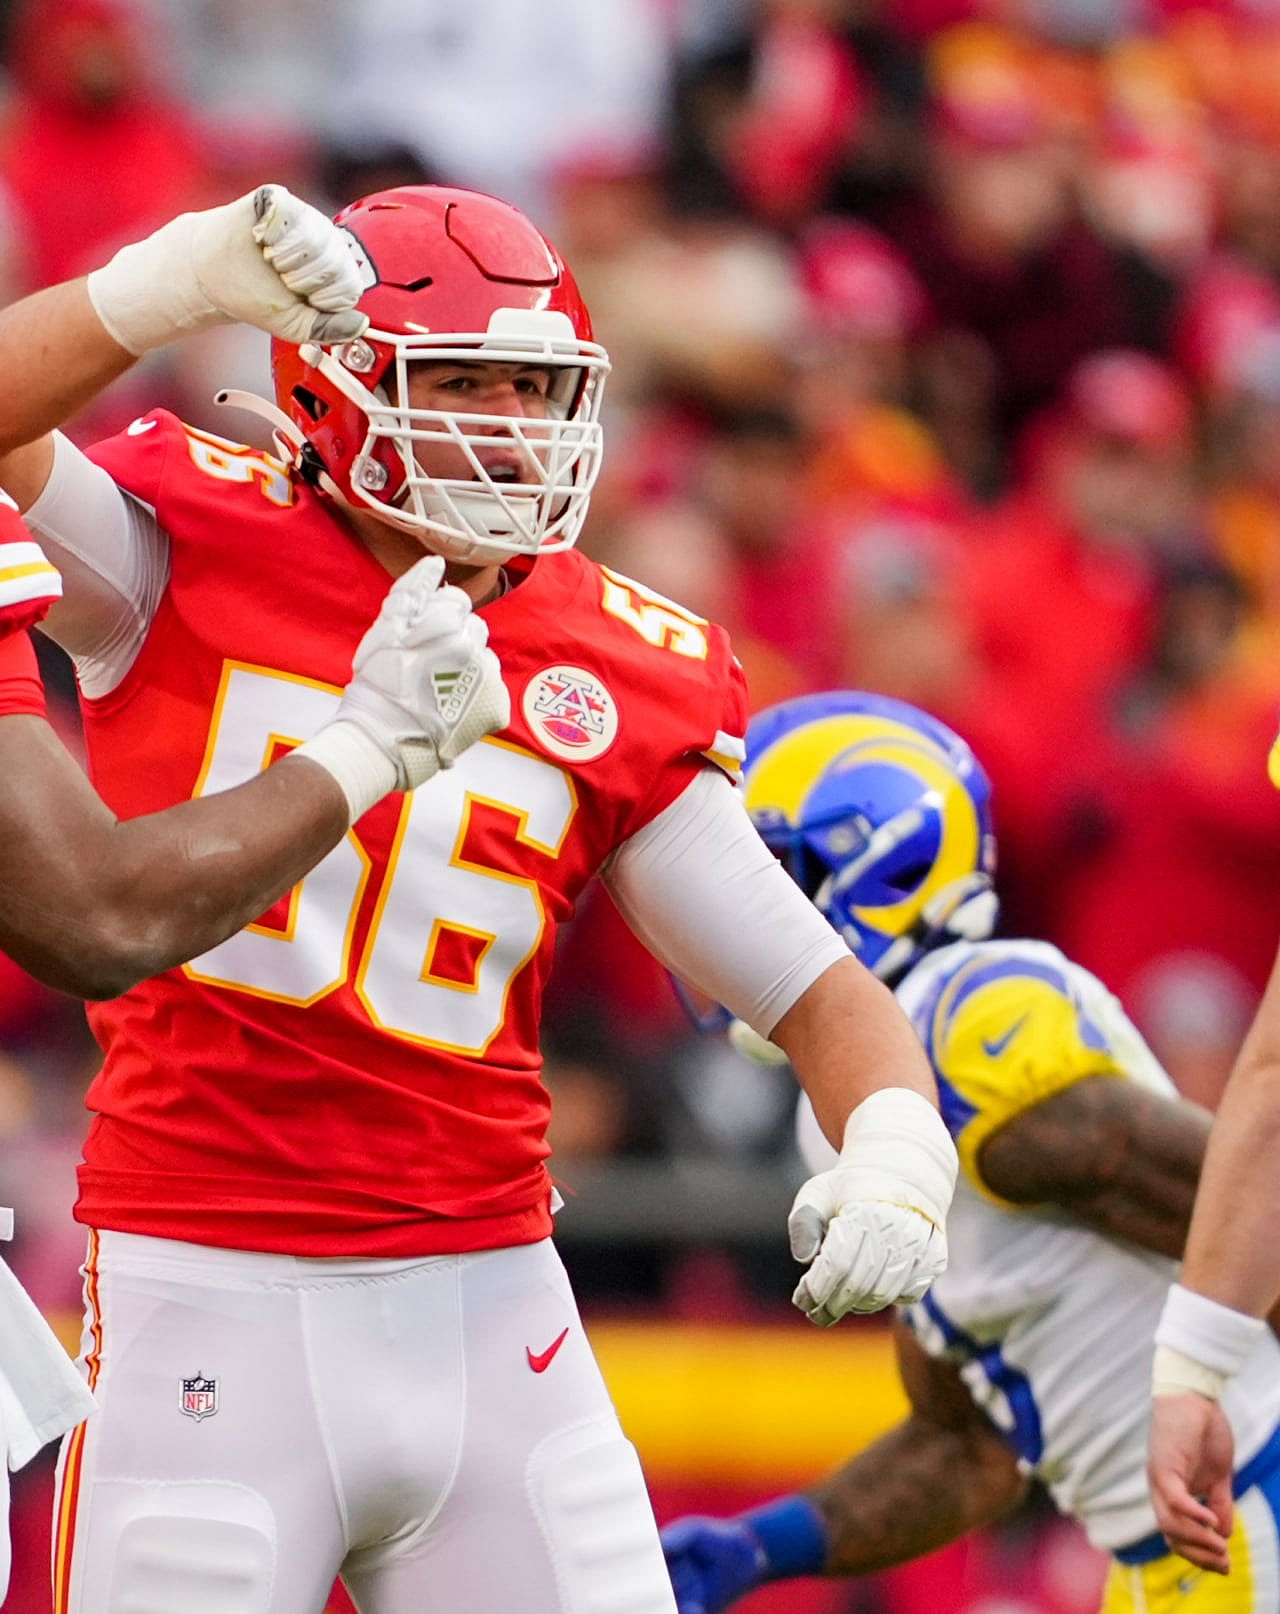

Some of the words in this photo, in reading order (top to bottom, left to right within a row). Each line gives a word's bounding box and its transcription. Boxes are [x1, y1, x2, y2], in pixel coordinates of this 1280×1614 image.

[444, 663, 480, 721] adidas
[180, 658, 579, 1057] 56
[186, 1393, 213, 1411] NFL
